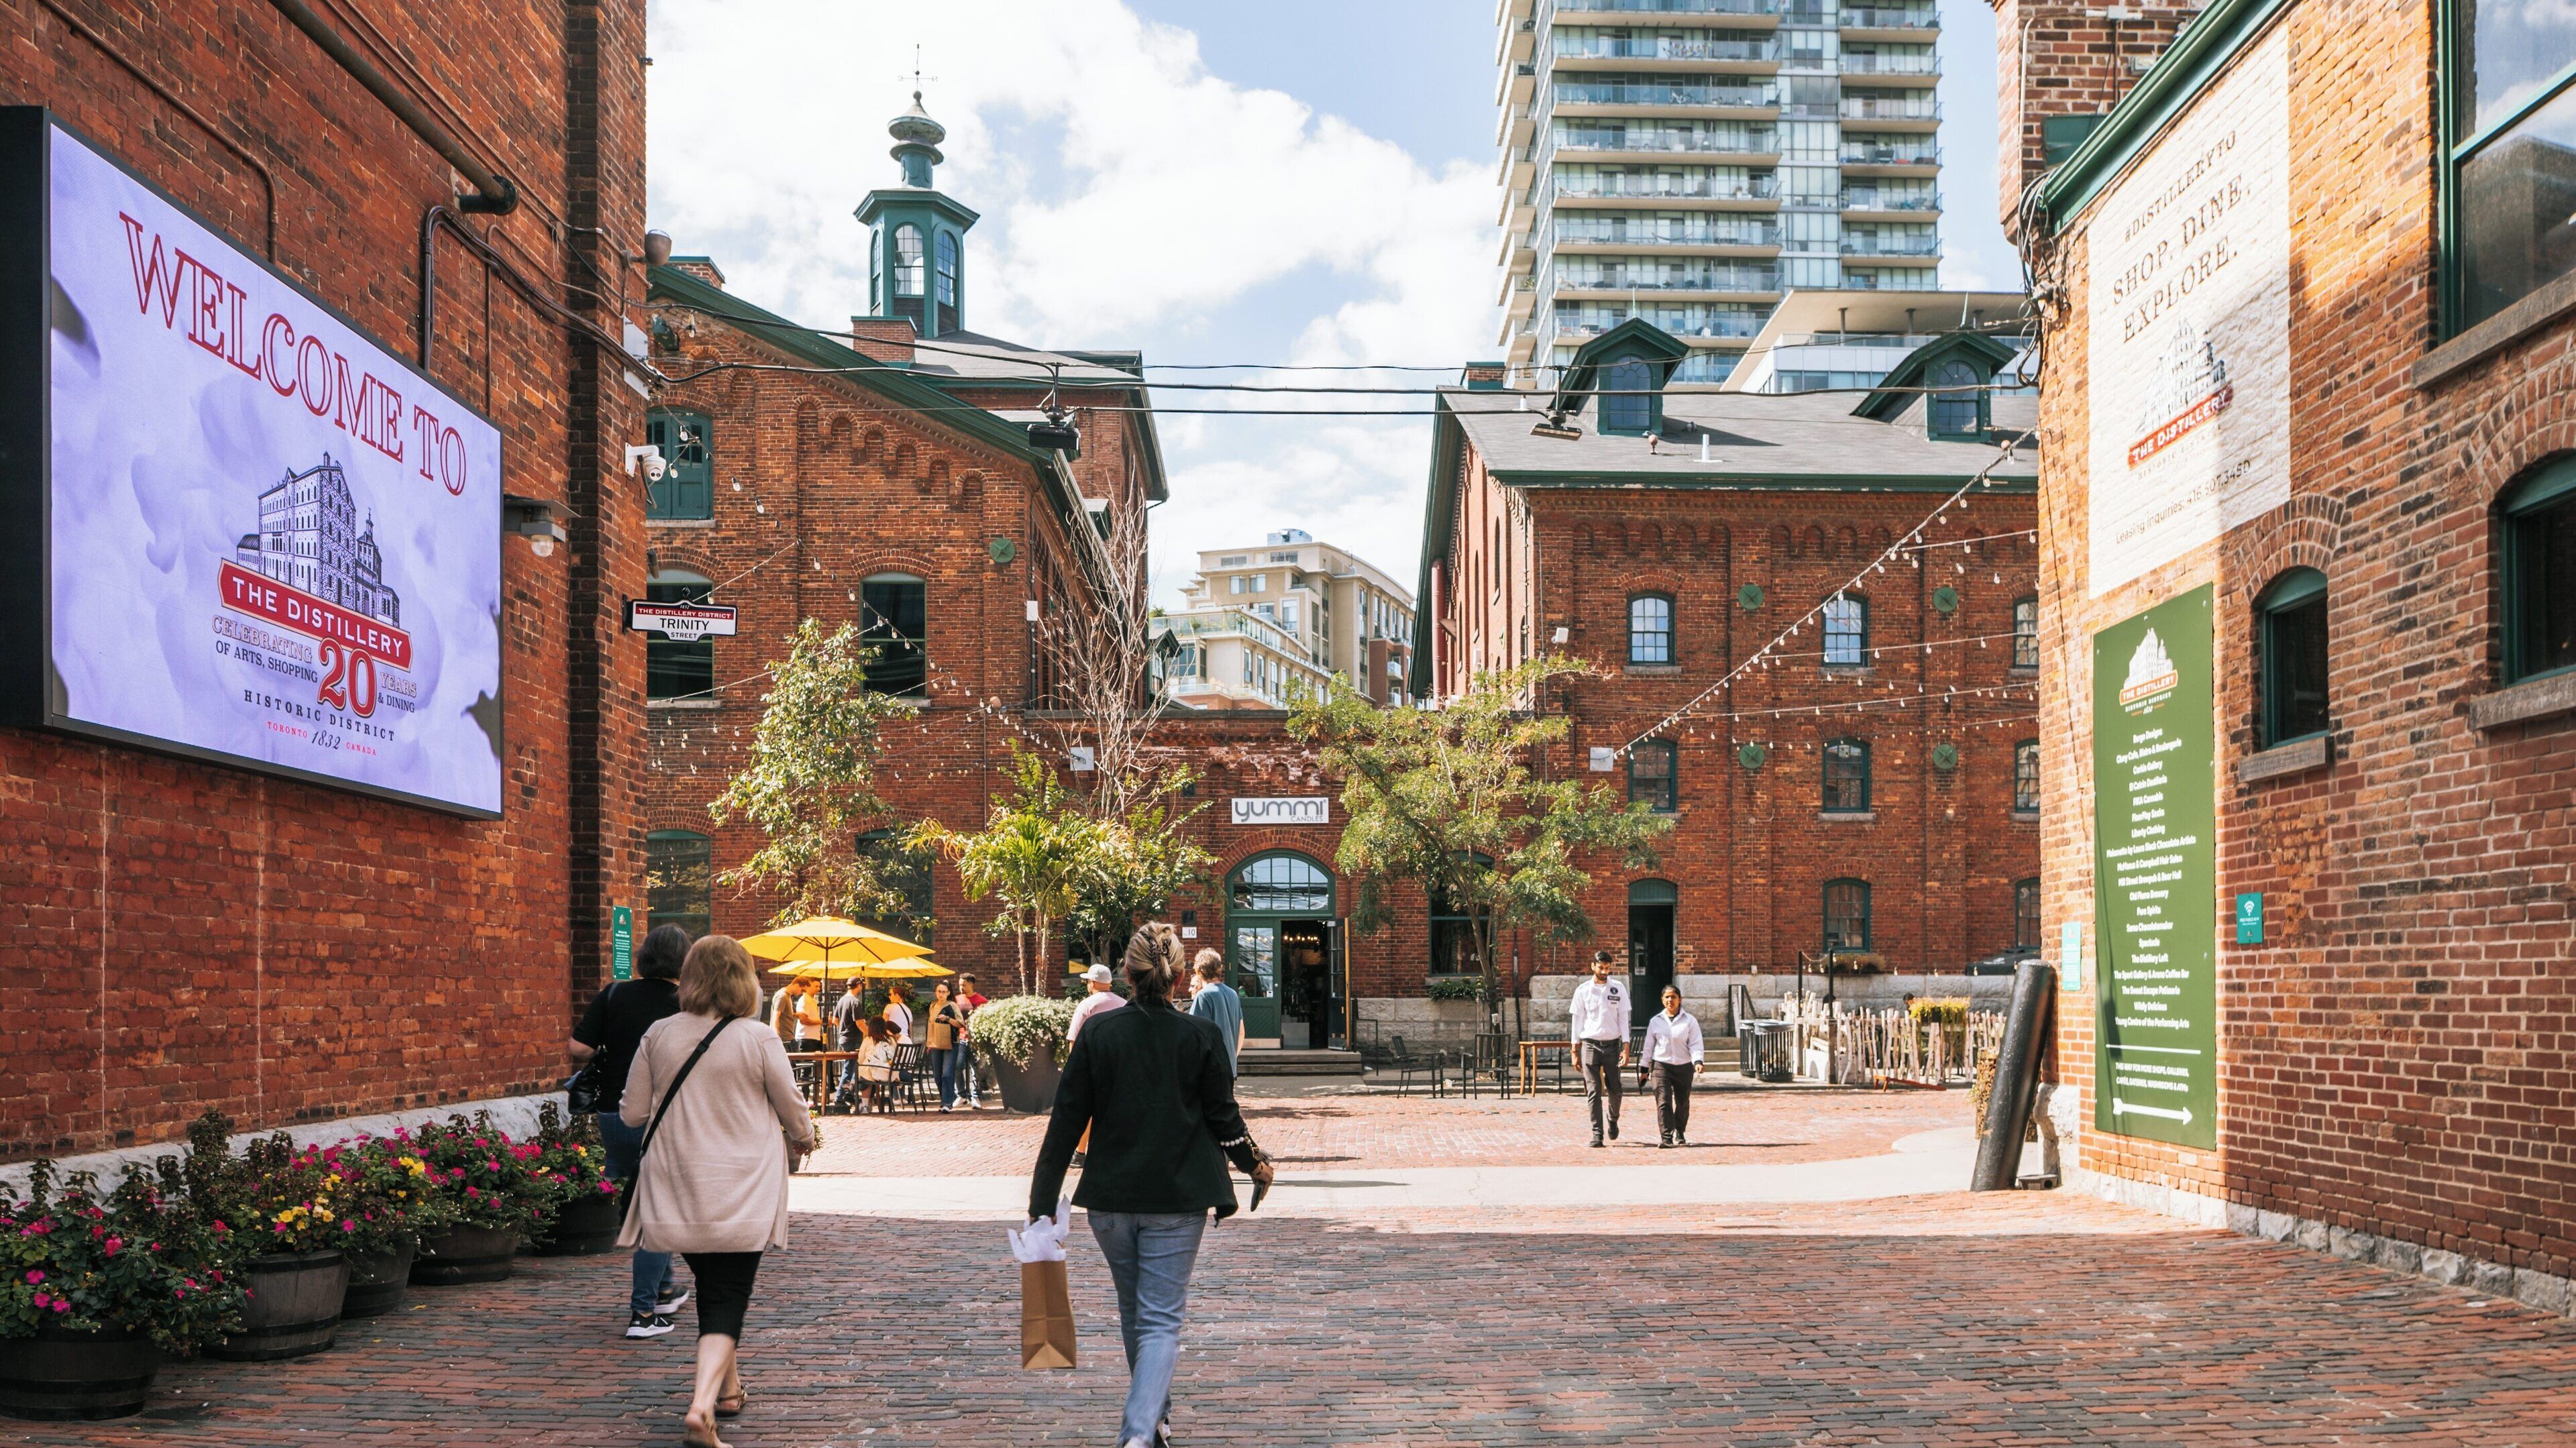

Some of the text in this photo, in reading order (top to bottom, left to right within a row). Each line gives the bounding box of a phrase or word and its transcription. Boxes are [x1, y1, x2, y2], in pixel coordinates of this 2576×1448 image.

[2124, 236, 2237, 343] EXPLORE.
[119, 211, 466, 496] WELCOME TO
[2133, 439, 2154, 461] THE
[2157, 390, 2227, 447] DISTILLERY
[2116, 522, 2145, 544] Leasing
[233, 577, 402, 657] THE DISTILLERY
[655, 609, 696, 617] DISTILLERY
[698, 611, 731, 619] DISTRICT
[659, 618, 710, 630] TRINITY
[211, 614, 417, 718] CELEBRATING 20 YEARS
[216, 640, 415, 714] OF ARTS, SHOPPING & DINING
[2123, 675, 2174, 701] THE DISTILLERY
[244, 689, 395, 742] HISTORIC DISTRICT
[267, 721, 377, 757] TORONTO 1832 CANADA
[2114, 970, 2122, 979] The
[2131, 954, 2140, 963] The
